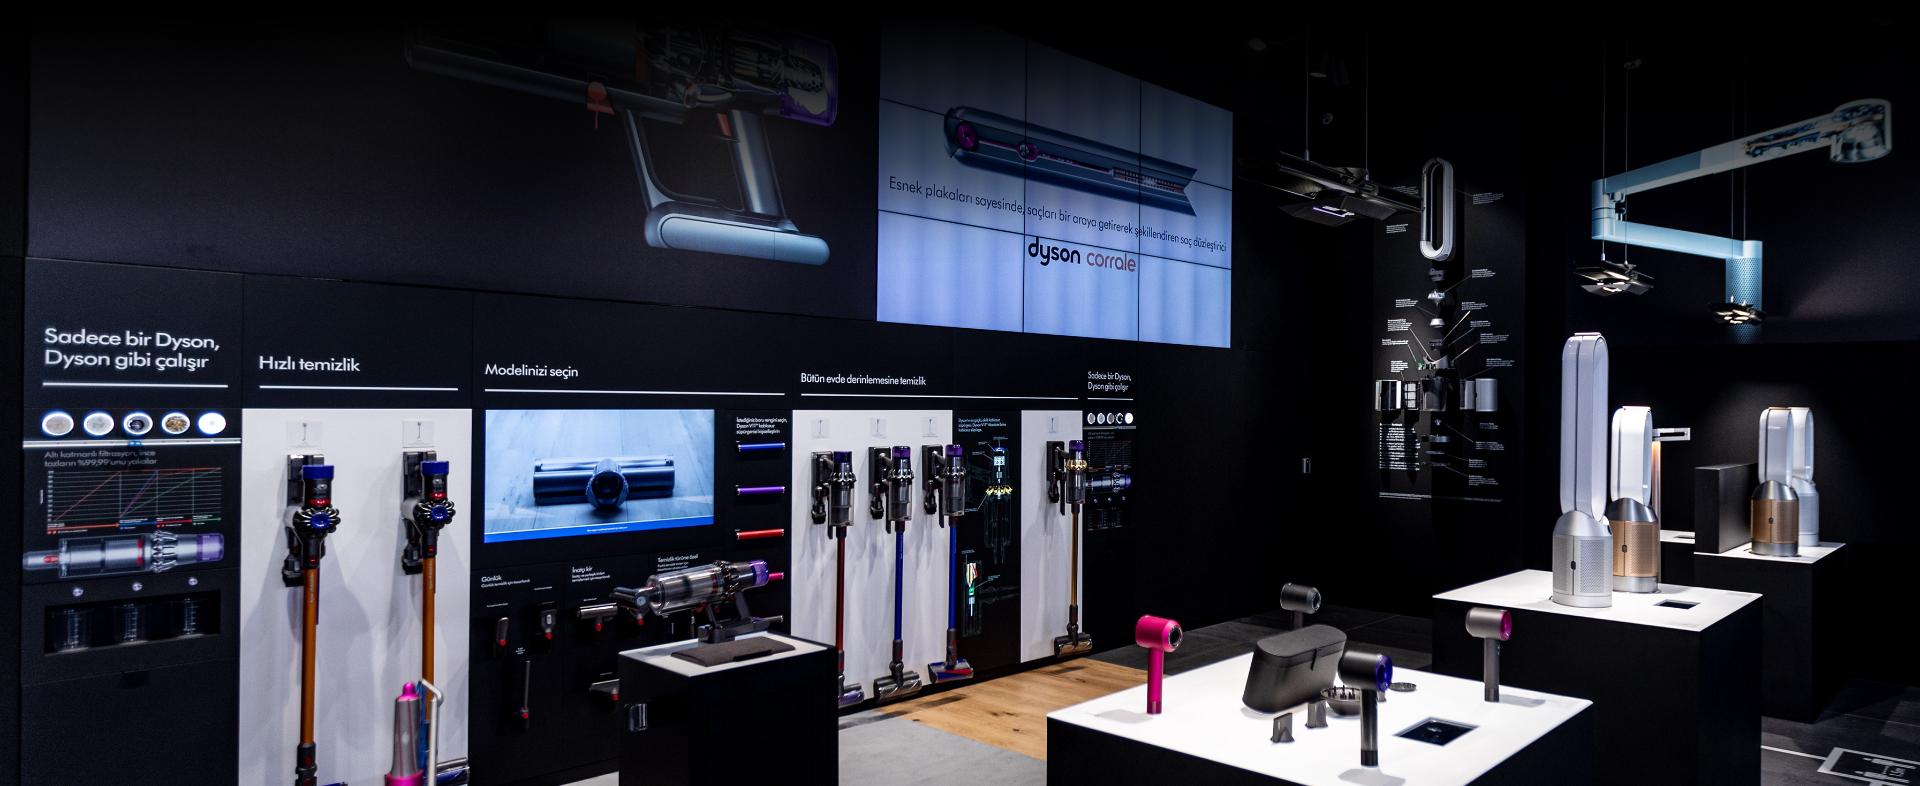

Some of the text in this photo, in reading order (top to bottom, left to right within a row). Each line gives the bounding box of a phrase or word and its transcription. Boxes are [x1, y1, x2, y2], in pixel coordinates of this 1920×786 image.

[889, 175, 1227, 252] Esnek plakaları sayesinde, saçları bir araya getirerek şekillendiren saç düzleştirici
[1028, 236, 1137, 272] dyson corrale
[44, 327, 220, 351] Sadece bir Dyson,
[45, 349, 209, 372] Dyson gibi çalışır
[259, 355, 360, 372] Hızlı temizlik
[485, 363, 578, 380] Modelinizi seçin
[800, 372, 926, 386] Bütün evde derinlemesine temizlik
[1088, 370, 1132, 381] Sadece bir Dyson,
[1088, 381, 1104, 391] Dyson
[60, 450, 98, 458] katmanlı
